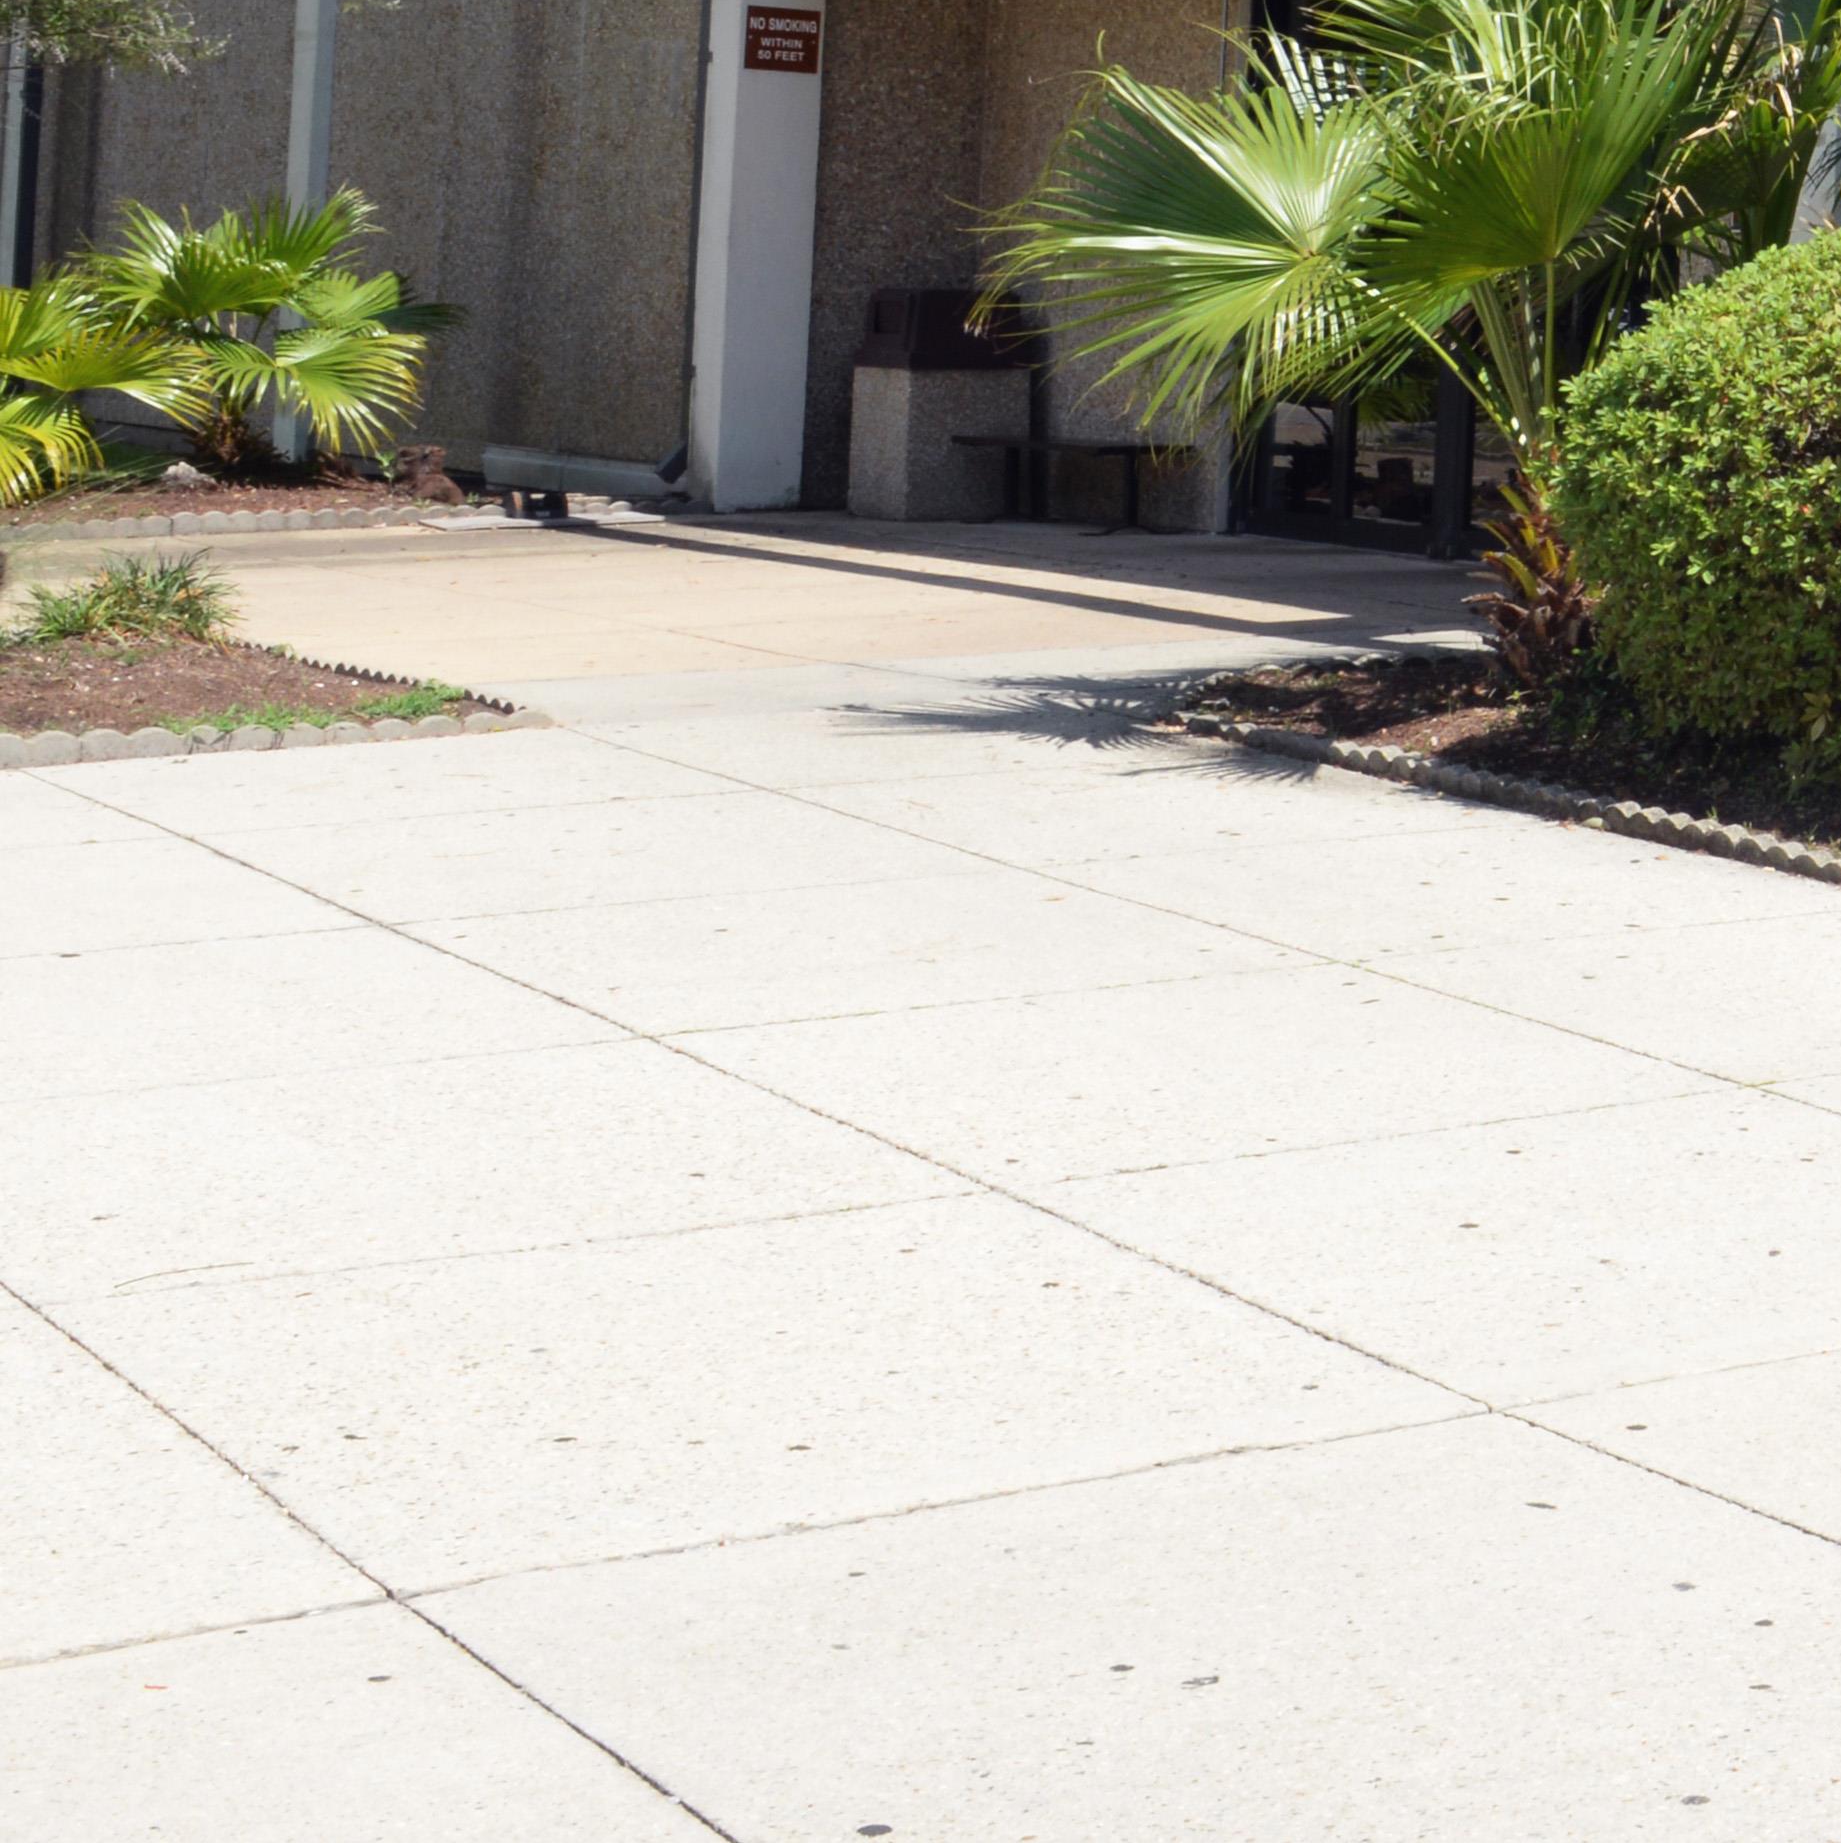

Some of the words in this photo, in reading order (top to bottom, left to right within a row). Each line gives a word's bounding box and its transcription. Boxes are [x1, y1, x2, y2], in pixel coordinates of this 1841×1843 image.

[750, 17, 766, 30] NO
[768, 18, 817, 33] SMOKING
[760, 37, 803, 49] WITHIN
[757, 49, 772, 60] 50
[774, 50, 805, 61] FEET
